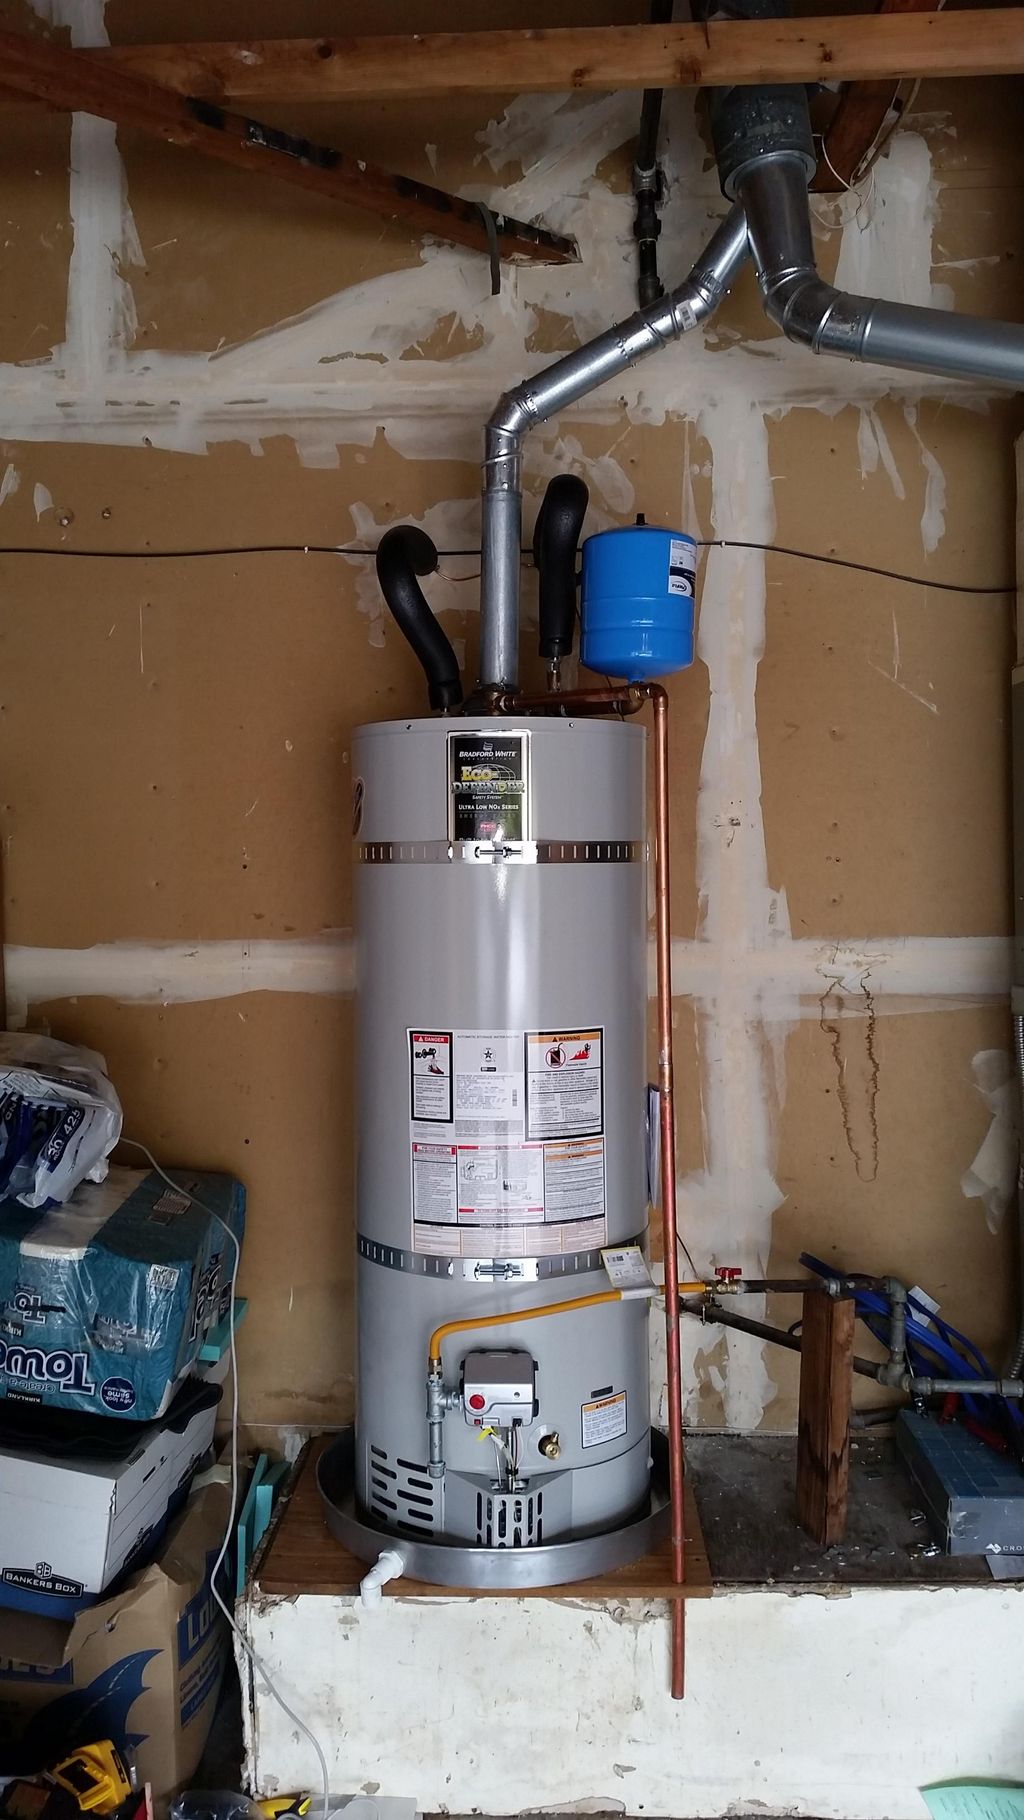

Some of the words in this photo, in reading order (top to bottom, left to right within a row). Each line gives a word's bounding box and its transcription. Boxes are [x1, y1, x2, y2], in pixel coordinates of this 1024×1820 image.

[452, 780, 526, 794] DEFENDER
[64, 1109, 80, 1135] 425
[0, 1338, 96, 1396] Tow
[8, 1392, 41, 1403] KIRKLAND
[600, 1398, 617, 1407] WARNING
[6, 1572, 52, 1589] BANKERS
[55, 1582, 76, 1594] BOX
